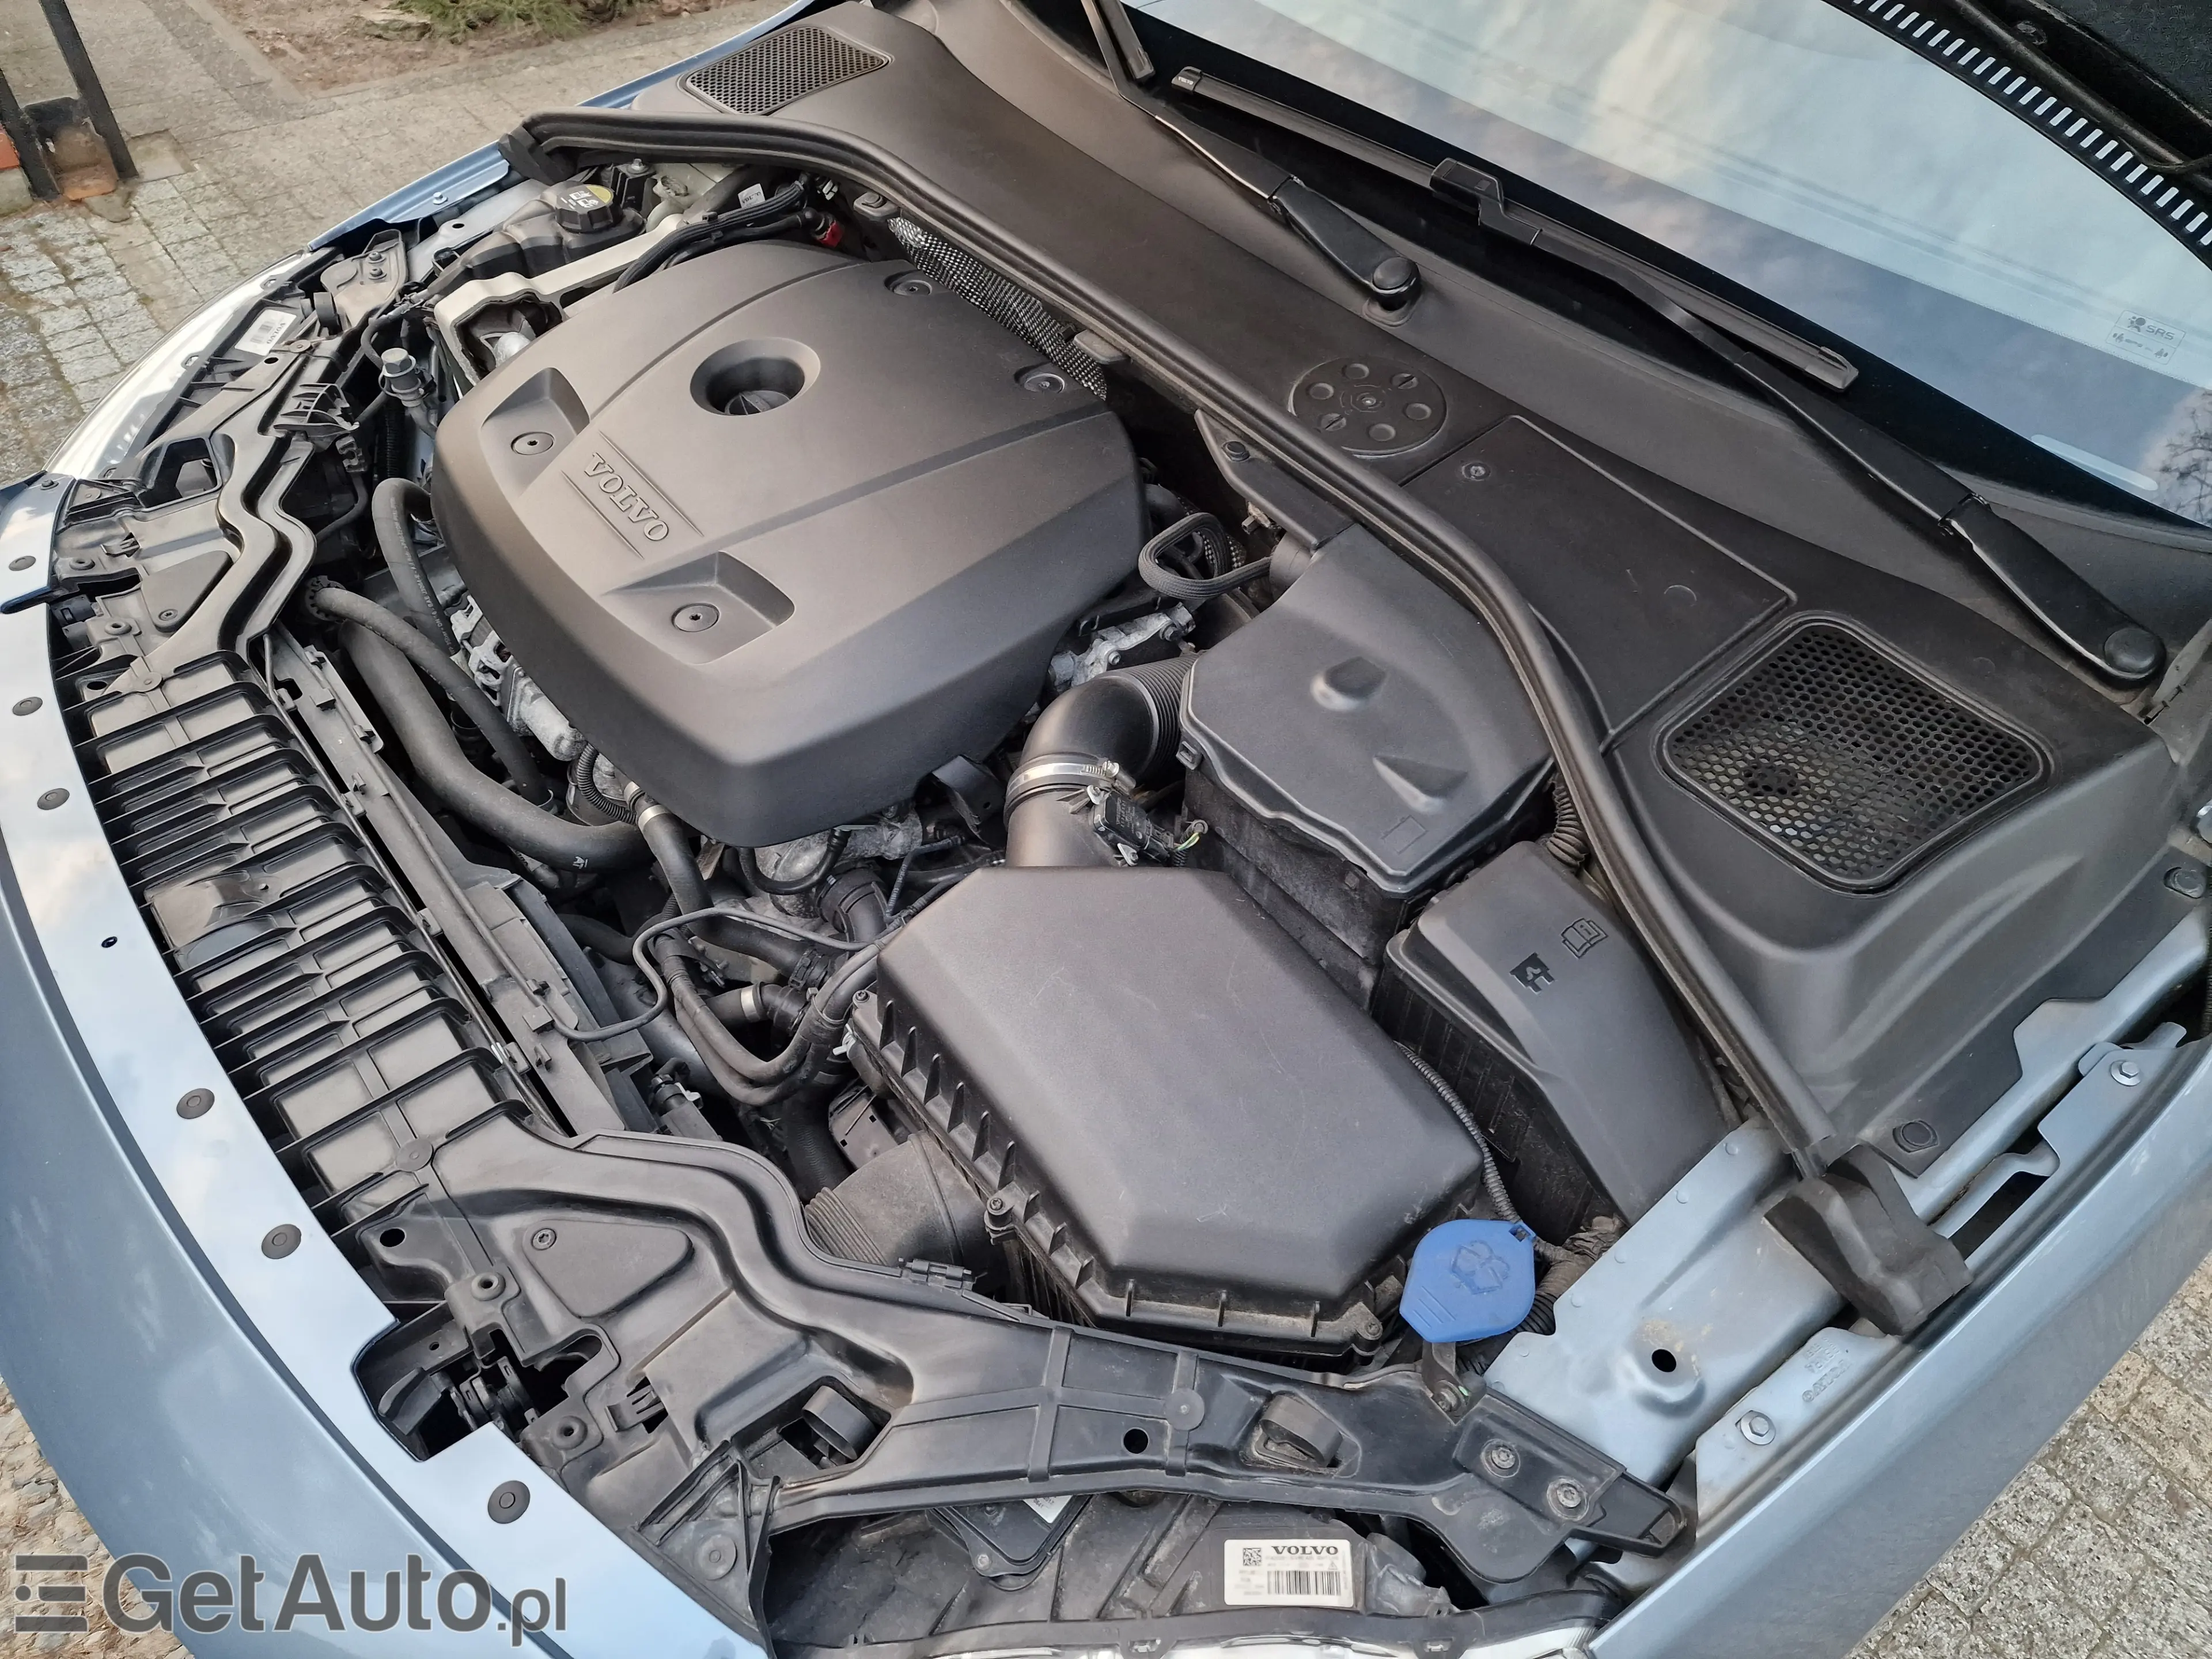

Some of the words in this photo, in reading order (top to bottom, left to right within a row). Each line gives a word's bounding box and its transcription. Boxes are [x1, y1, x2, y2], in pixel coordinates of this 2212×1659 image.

[267, 323, 286, 344] VOLVO
[2146, 324, 2175, 340] SRS
[584, 452, 669, 541] VOLVO
[1271, 1546, 1338, 1555] VOLVO
